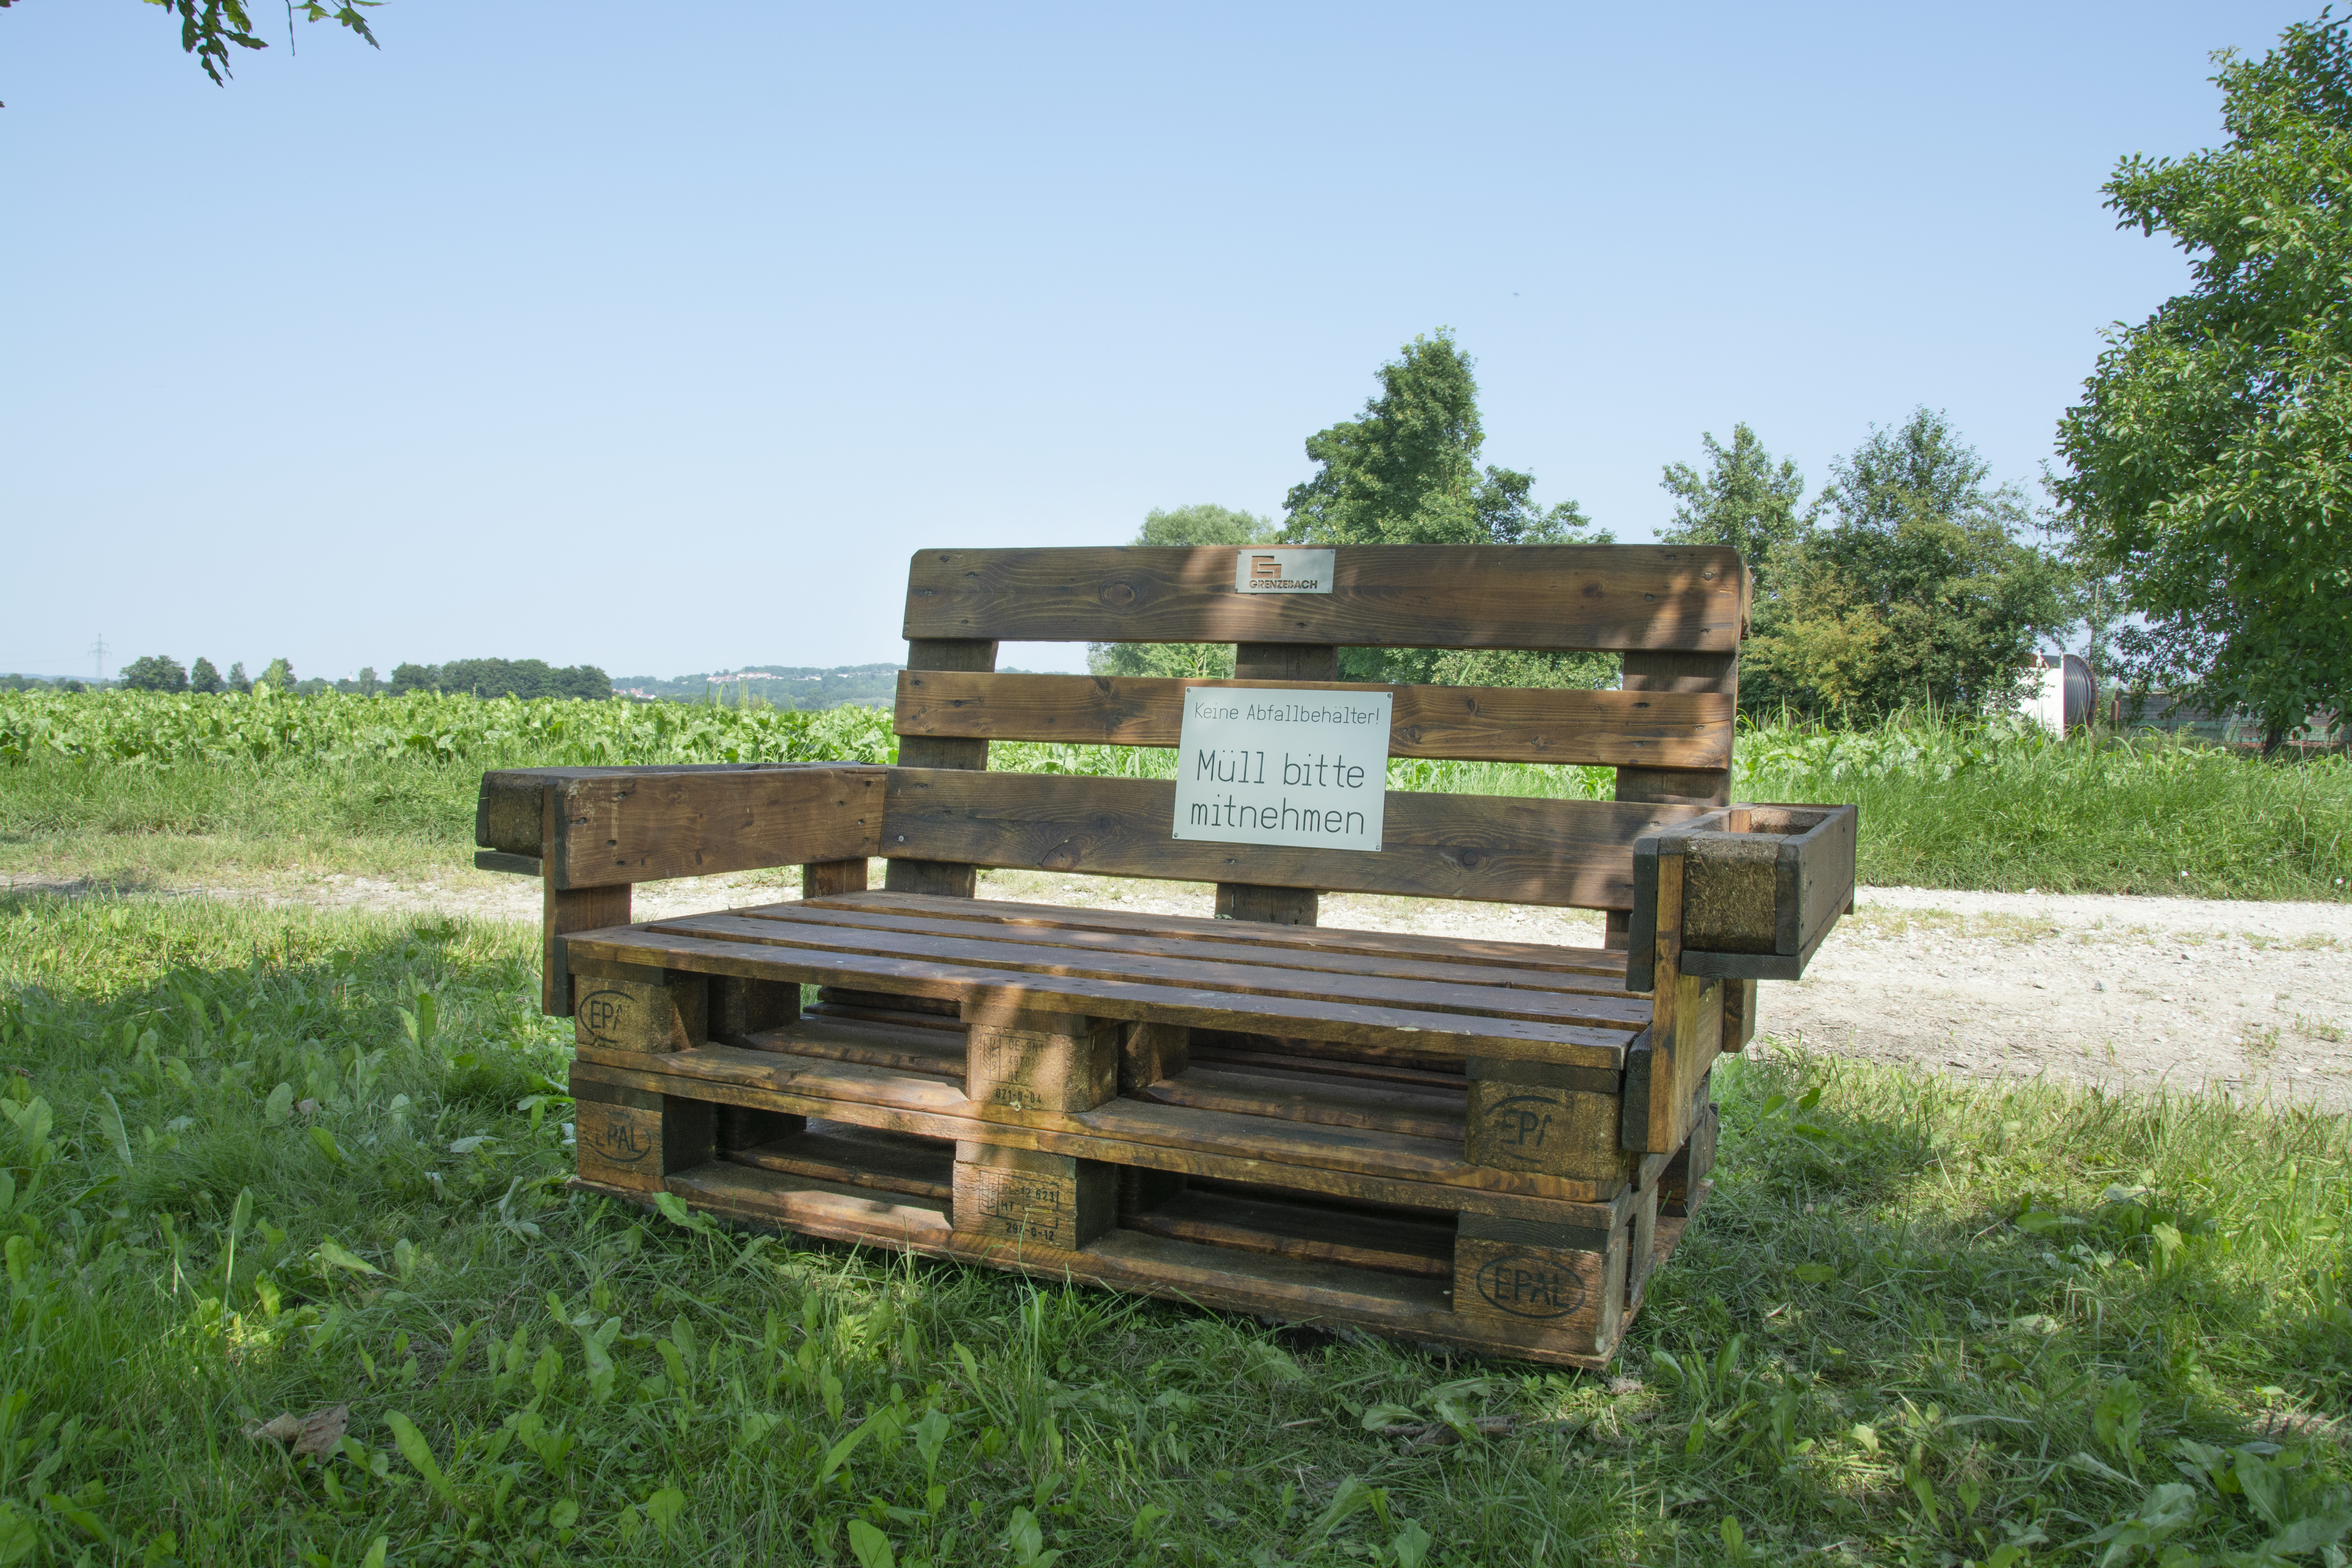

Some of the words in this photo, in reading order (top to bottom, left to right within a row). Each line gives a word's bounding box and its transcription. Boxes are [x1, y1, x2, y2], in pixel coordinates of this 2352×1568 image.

[1249, 580, 1318, 589] GRENZEBACH
[1194, 702, 1239, 719] Keine
[1247, 704, 1379, 724] Abfallbehälter!
[1197, 749, 1265, 784] Müll
[1283, 752, 1365, 788] bitte
[1191, 793, 1365, 835] mitnehmen
[996, 1088, 1042, 1104] 021-0-04
[1035, 1189, 1055, 1202] 623
[1001, 1200, 1014, 1212] HT
[1494, 1267, 1570, 1308] EPAL
